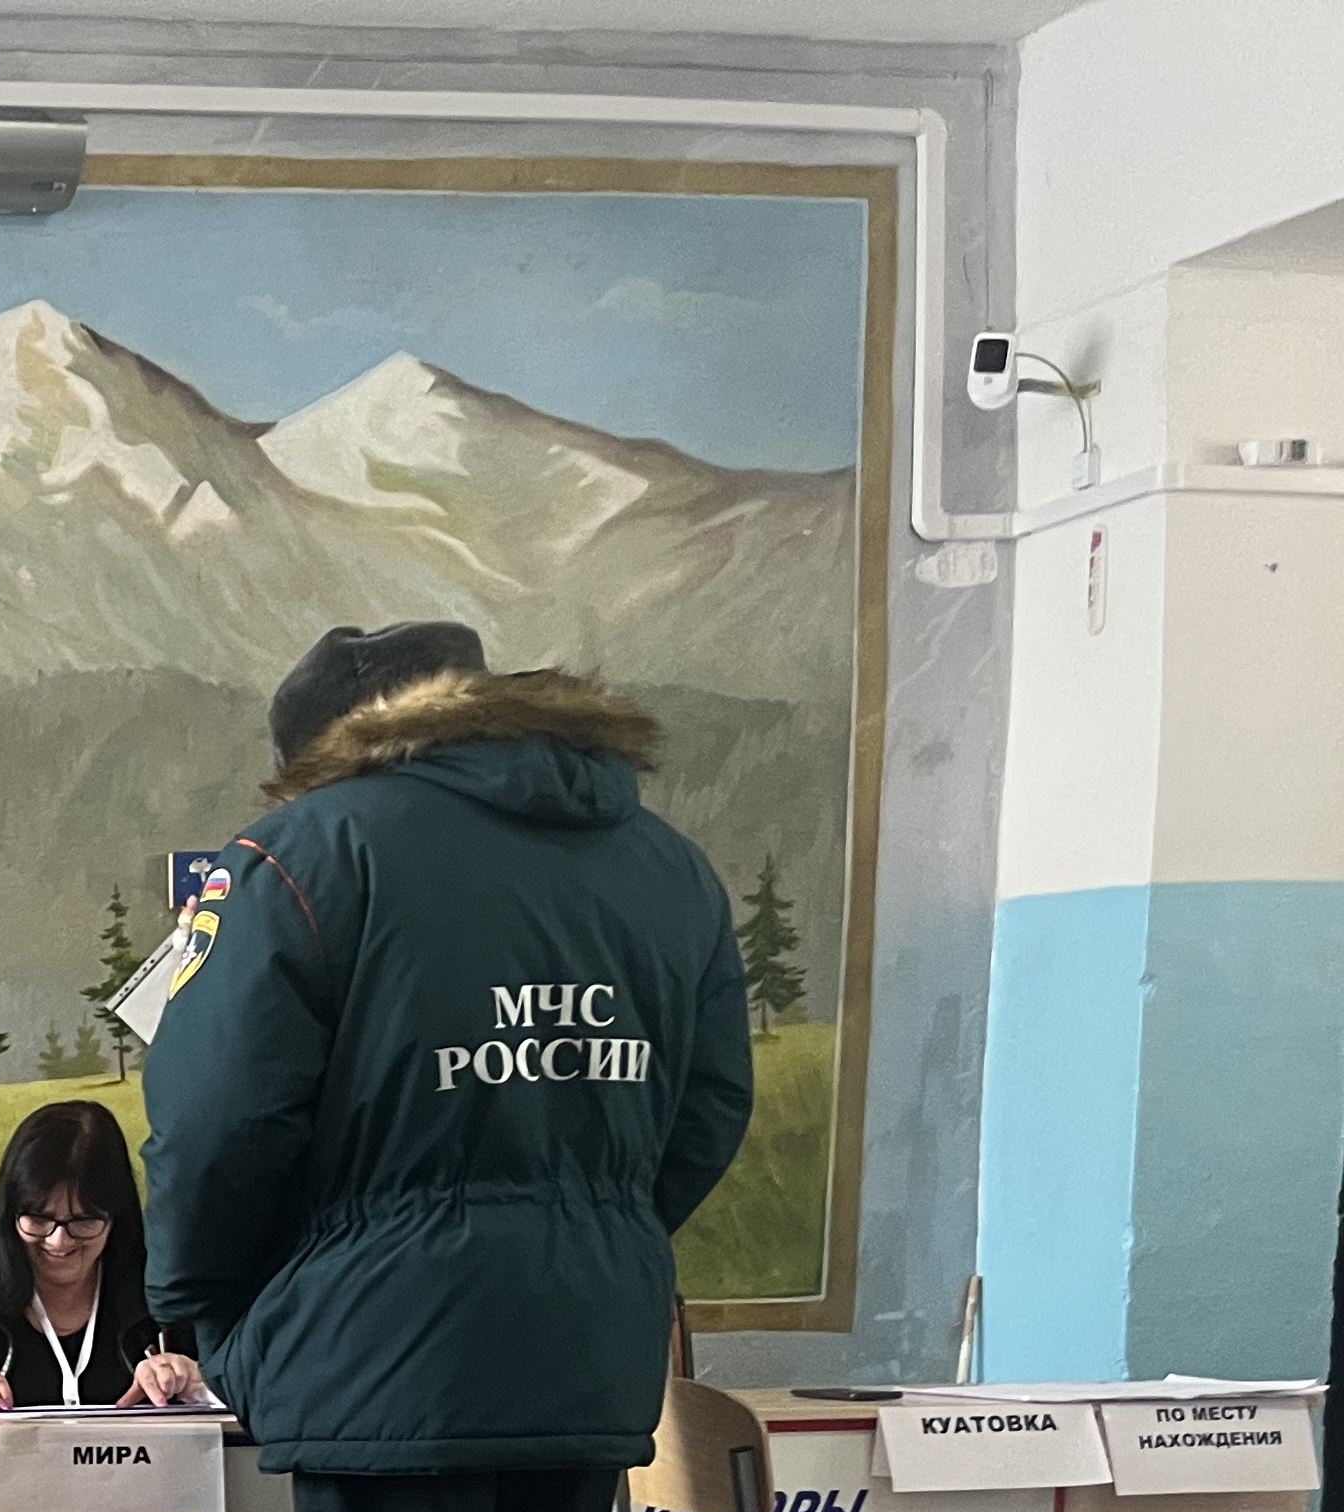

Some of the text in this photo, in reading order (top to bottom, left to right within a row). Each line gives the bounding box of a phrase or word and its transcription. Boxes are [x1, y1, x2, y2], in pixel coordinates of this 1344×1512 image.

[491, 984, 615, 1029] МЧС
[434, 1038, 652, 1092] РОССИИ
[1156, 1405, 1258, 1423] ПО МЕСТУ
[921, 1414, 1057, 1434] КУАТОВКА
[1138, 1431, 1283, 1449] НАХОЖДЕНИЯ
[73, 1446, 151, 1465] МИРА
